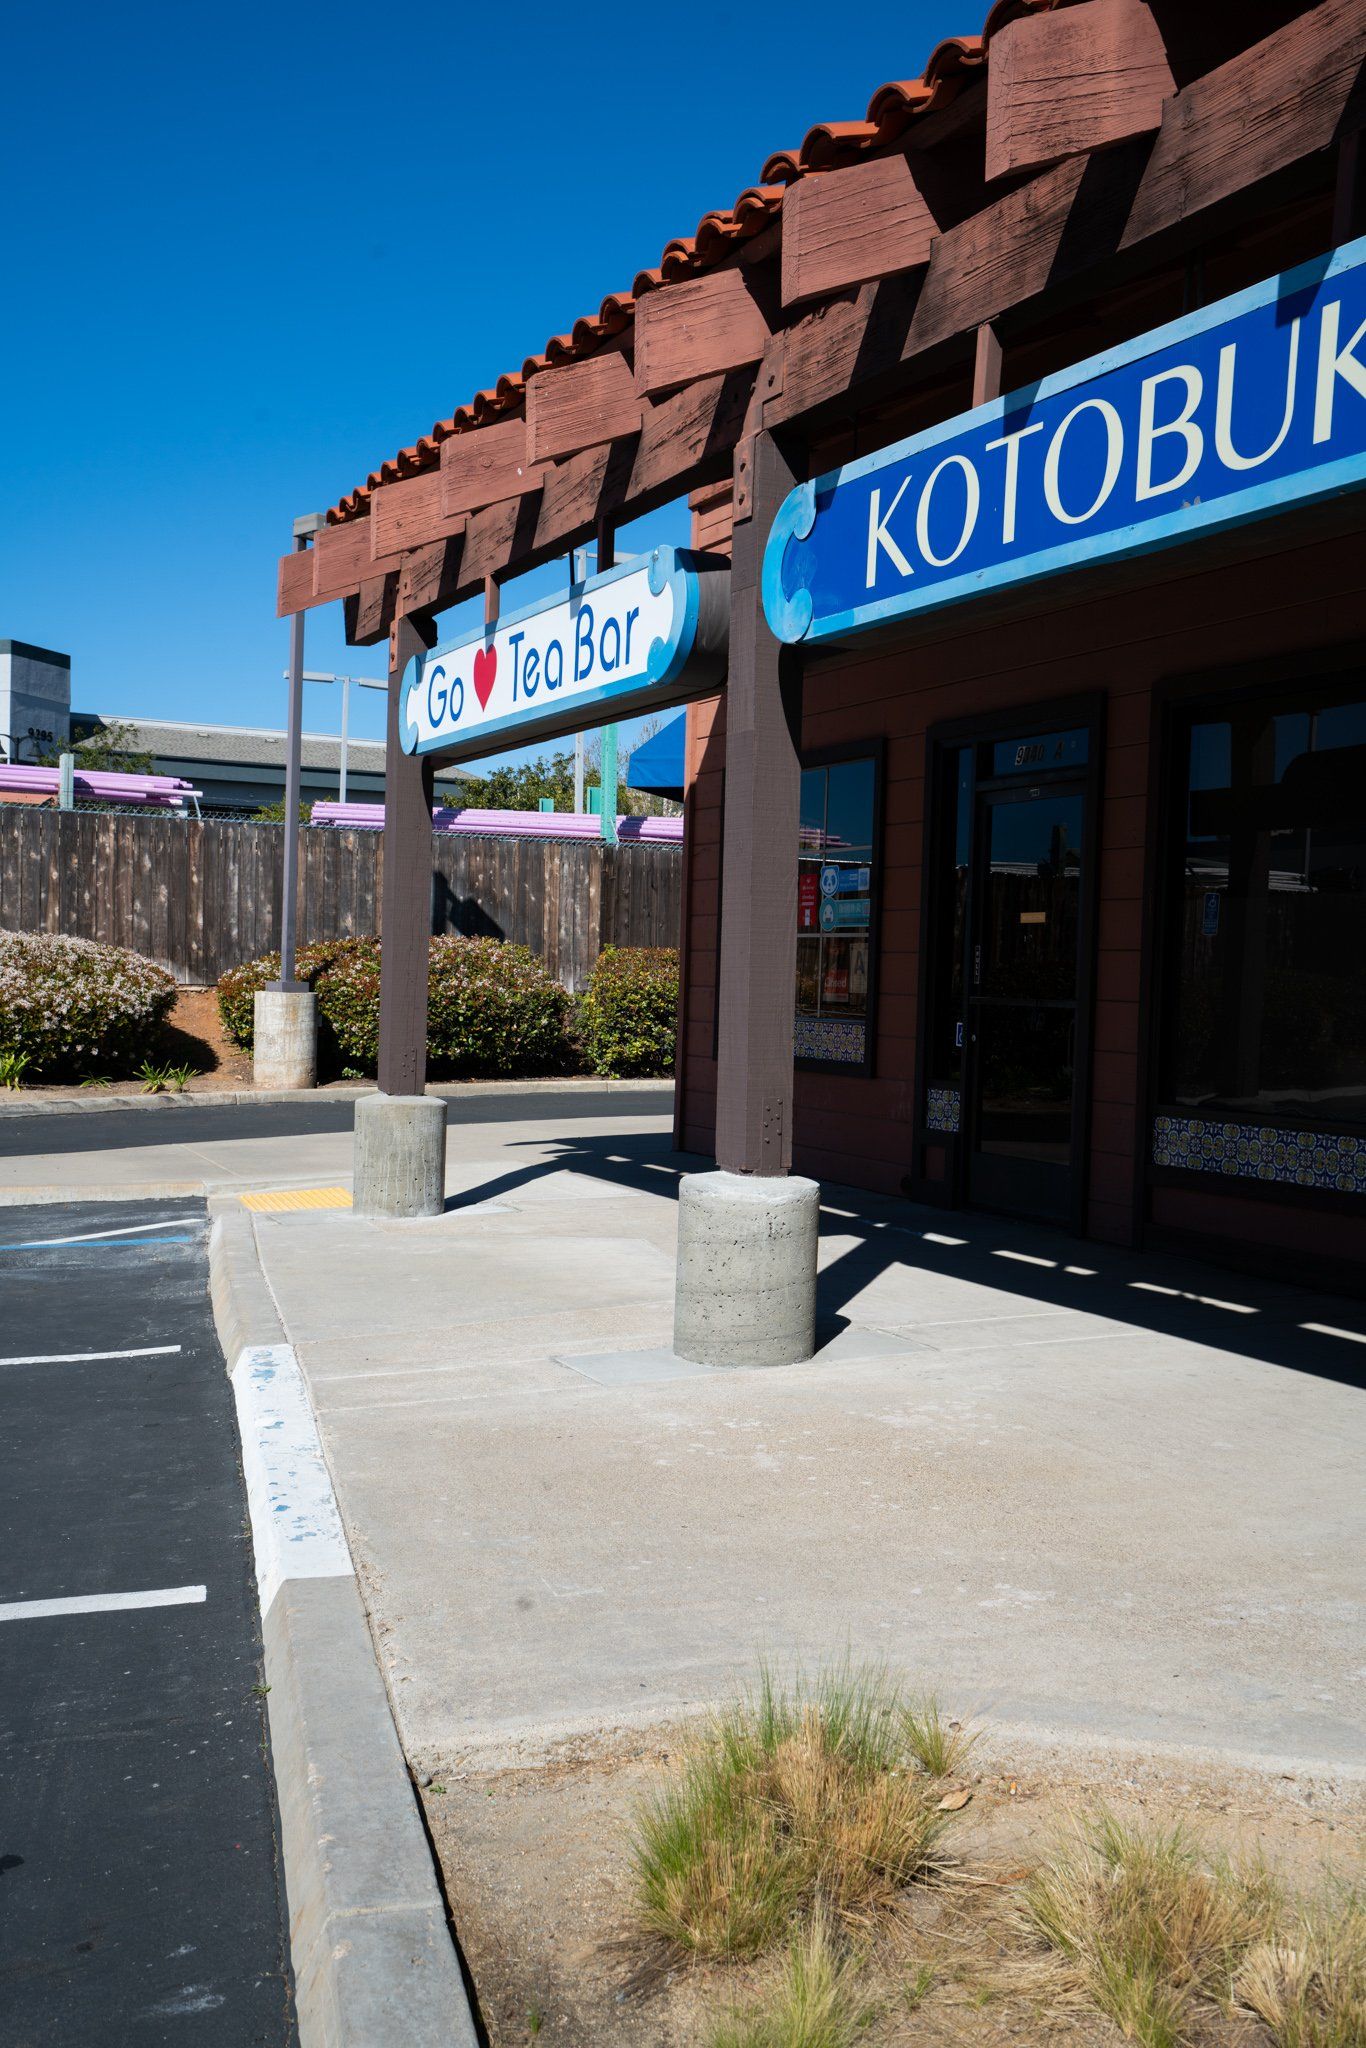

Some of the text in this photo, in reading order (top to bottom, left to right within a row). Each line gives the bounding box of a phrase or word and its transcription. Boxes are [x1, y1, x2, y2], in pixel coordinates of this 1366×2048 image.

[865, 300, 1366, 588] KOTOBUK
[428, 604, 639, 728] Go Tea Bar
